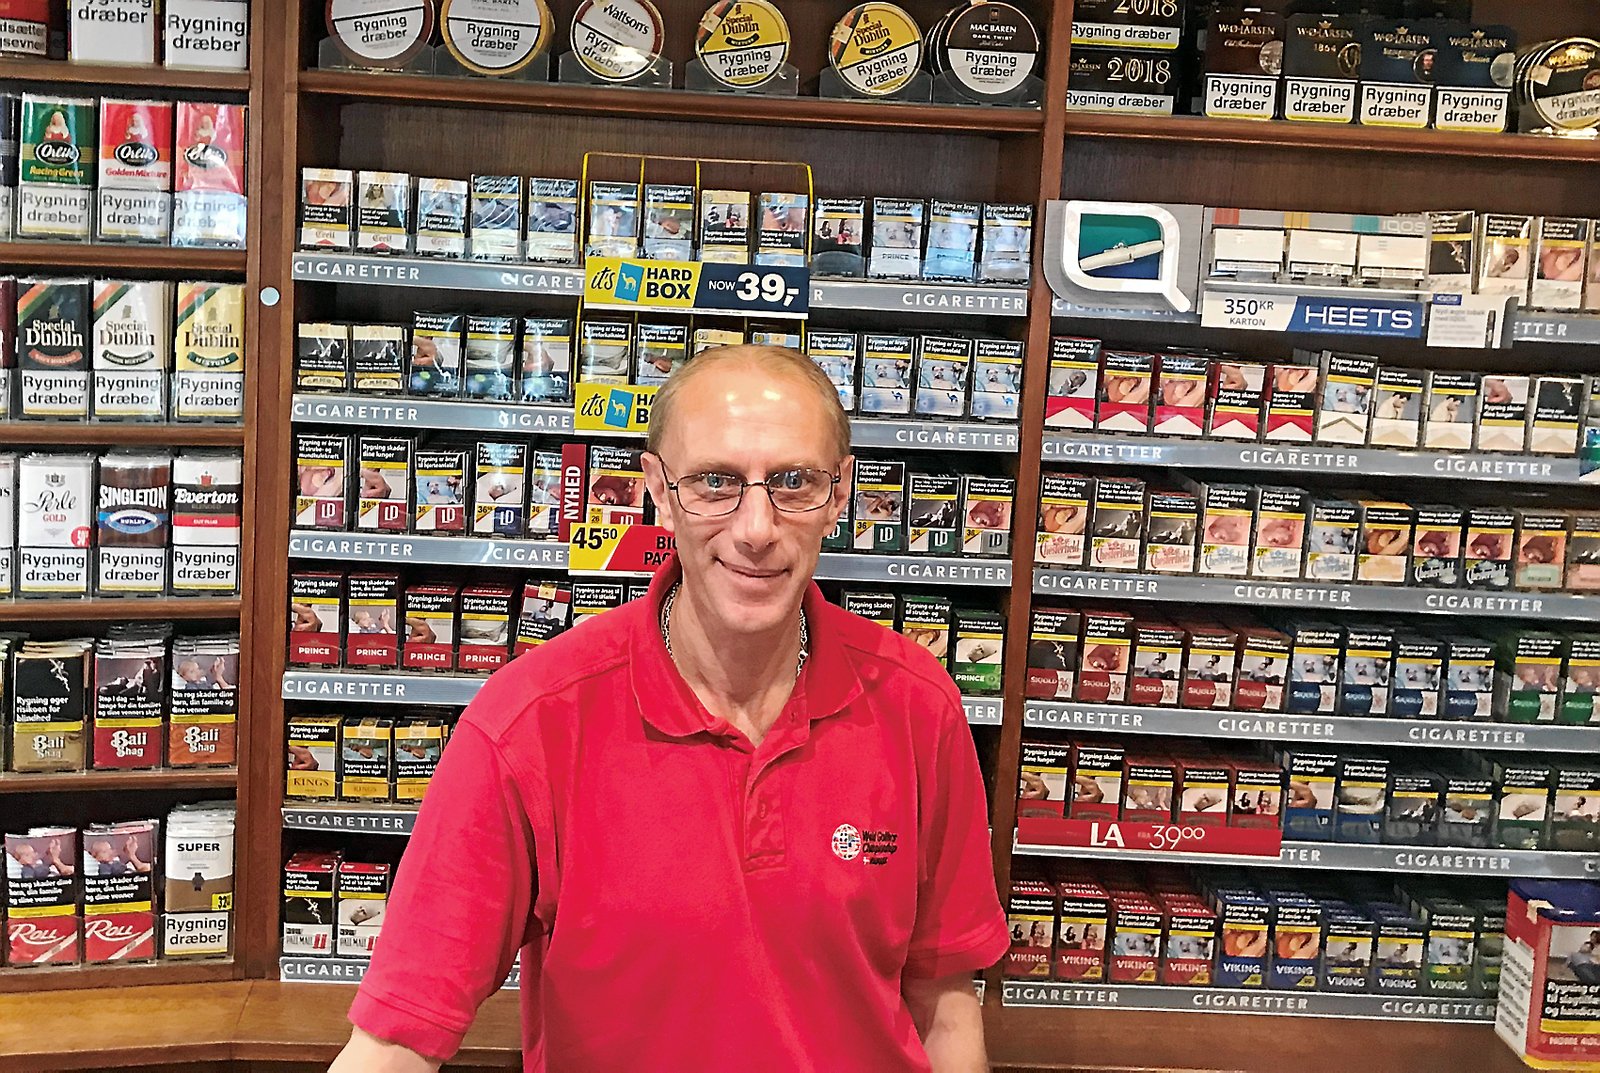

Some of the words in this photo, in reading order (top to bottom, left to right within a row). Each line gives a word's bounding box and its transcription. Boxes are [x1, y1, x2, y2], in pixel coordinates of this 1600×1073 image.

[78, 6, 147, 23] dræber
[168, 15, 245, 36] Rygning
[354, 16, 407, 33] Rygning
[467, 23, 520, 40] Rygning
[722, 22, 759, 36] Dublin
[970, 24, 989, 32] MAC
[990, 24, 1017, 33] BAREN
[362, 28, 407, 43] dræber
[853, 27, 890, 47] Dublin
[1072, 24, 1120, 40] Rygning
[1125, 27, 1171, 41] dræber
[173, 36, 241, 51] dræber
[472, 37, 517, 51] dræber
[719, 50, 771, 66] Rygning
[857, 52, 908, 77] Rygning
[966, 51, 1017, 67] Rygning
[724, 64, 769, 78] dræber
[865, 65, 908, 88] dræber
[970, 65, 1015, 77] dræber
[1107, 56, 1171, 84] 2018
[1211, 80, 1272, 97] Rygning
[1290, 83, 1351, 100] Rygning
[1366, 85, 1427, 103] Rygning
[1066, 91, 1115, 107] Rygning
[1119, 94, 1164, 108] dræber
[1214, 97, 1267, 110] dræber
[1293, 100, 1346, 113] dræber
[1441, 94, 1503, 110] Rygning
[1368, 105, 1421, 119] dræber
[1444, 110, 1498, 123] dræber
[23, 193, 87, 210] Rygning
[103, 194, 166, 212] Rygning
[27, 209, 83, 223] dræber
[107, 212, 162, 225] dræber
[294, 261, 420, 280] CIGARETTER
[646, 267, 692, 281] HARD
[646, 282, 691, 300] BOX
[708, 280, 736, 290] NOW
[902, 293, 1023, 310] CIGARETTER
[1224, 299, 1258, 315] 350
[1259, 300, 1274, 310] KR
[1229, 318, 1265, 326] KARTON
[1305, 305, 1413, 329] HEETS
[33, 320, 75, 333] Special
[25, 328, 83, 347] Dublin
[101, 331, 155, 346] Dublin
[185, 332, 239, 348] Dublin
[24, 376, 87, 391] Rygning
[96, 377, 158, 392] Rygning
[181, 378, 241, 394] Rygning
[28, 392, 83, 404] dræber
[101, 394, 155, 404] dræber
[185, 395, 239, 406] dræber
[294, 404, 418, 421] CIGARETTER
[499, 412, 571, 428] CIGARE
[895, 429, 1016, 446] CIGARETTER
[1042, 442, 1162, 459] CIGARETTER
[1240, 450, 1358, 469] CIGARETTER
[1434, 458, 1552, 476] CIGARETTER
[100, 485, 167, 509] SINGLETON
[174, 488, 238, 504] Everton
[563, 466, 580, 520] NYHED
[43, 514, 66, 522] GOLD
[321, 502, 336, 519] LD
[385, 505, 399, 520] LD
[441, 508, 455, 523] LD
[500, 510, 514, 525] LD
[880, 527, 893, 543] LD
[934, 531, 948, 546] LD
[290, 538, 413, 556] CIGARETTER
[22, 554, 84, 568] Rygning
[102, 553, 163, 568] Rygning
[175, 552, 235, 566] Rygning
[493, 547, 564, 563] CIGARE
[26, 570, 81, 581] dræber
[105, 570, 159, 581] dræber
[178, 568, 231, 579] dræber
[888, 563, 1006, 581] CIGARETTER
[1039, 575, 1158, 593] CIGARETTER
[1234, 585, 1351, 602] CIGARETTER
[1426, 594, 1543, 613] CIGARETTER
[299, 647, 329, 655] PRINCE
[410, 653, 445, 661] PRINCE
[466, 655, 501, 663] PRINCE
[956, 674, 985, 682] PRINCE
[283, 680, 406, 696] CIGARETTER
[1026, 708, 1143, 727] CIGARETTER
[1218, 718, 1335, 736] CIGARETTER
[111, 730, 147, 748] Bali
[183, 726, 219, 744] Bali
[1408, 727, 1526, 744] CIGARETTER
[33, 735, 64, 751] Bali
[189, 741, 215, 753] Shag
[117, 746, 143, 757] Shag
[293, 778, 329, 787] KINGS
[284, 814, 404, 829] CIGARETTER
[1090, 822, 1125, 848] LA
[177, 843, 220, 851] SUPER
[1395, 853, 1511, 871] CIGARETTER
[167, 918, 226, 932] Rygning
[170, 934, 222, 945] dræber
[1010, 953, 1047, 963] VIKING
[1062, 956, 1100, 965] VIKING
[1117, 960, 1154, 970] VIKING
[283, 963, 367, 977] CIGARET
[1170, 963, 1207, 972] VIKING
[1223, 962, 1261, 974] VIKING
[1276, 965, 1314, 976] VIKING
[1327, 976, 1365, 987] VIKING
[1378, 978, 1416, 989] VIKING
[1430, 980, 1468, 990] VIKING
[1003, 987, 1119, 1002] CIGARETTER
[1192, 993, 1309, 1011] CIGARETTER
[1382, 1001, 1496, 1016] CIGARETTER
